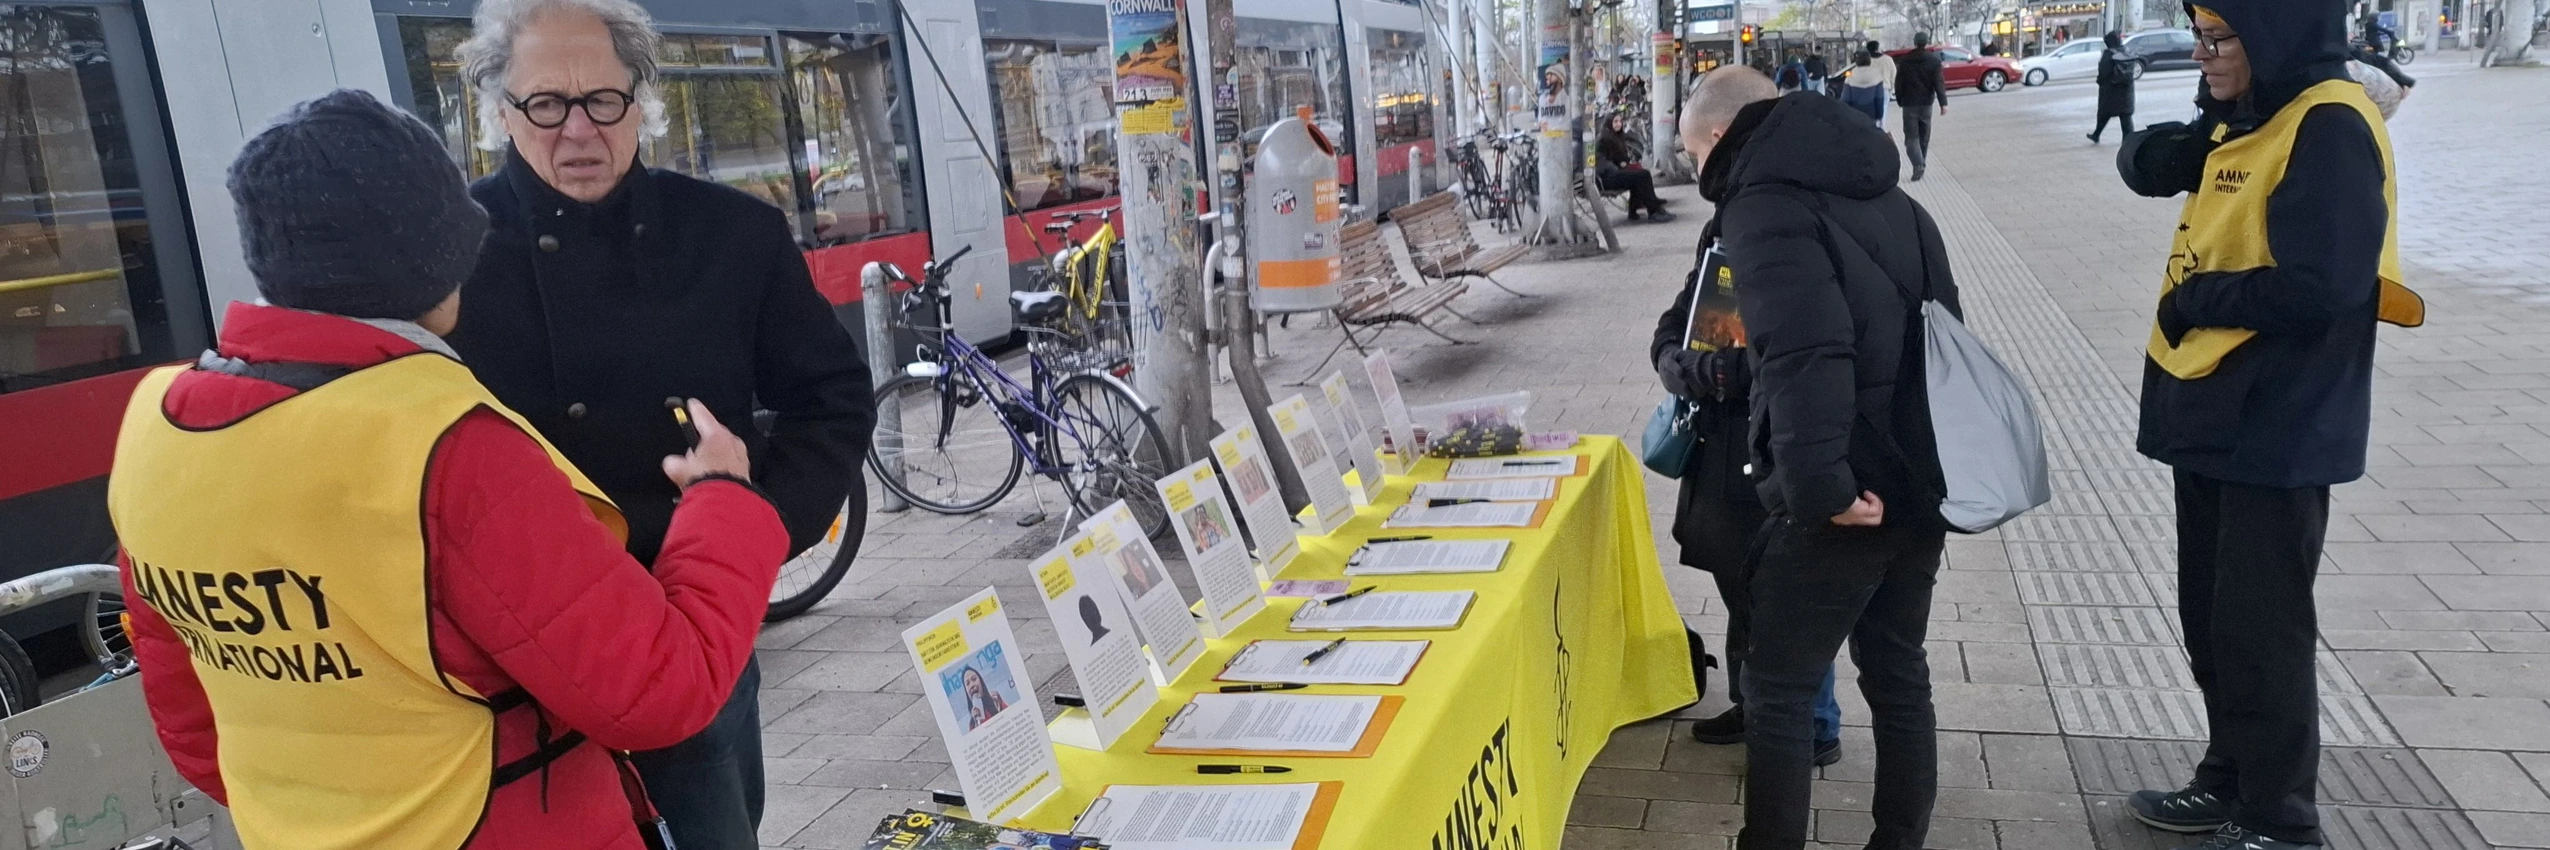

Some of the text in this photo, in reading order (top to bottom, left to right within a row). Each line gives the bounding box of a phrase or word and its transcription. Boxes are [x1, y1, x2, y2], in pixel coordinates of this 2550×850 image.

[1111, 0, 1175, 16] CORNWALL
[1541, 40, 1569, 48] CORNWAL
[1541, 105, 1566, 117] DAVIDO
